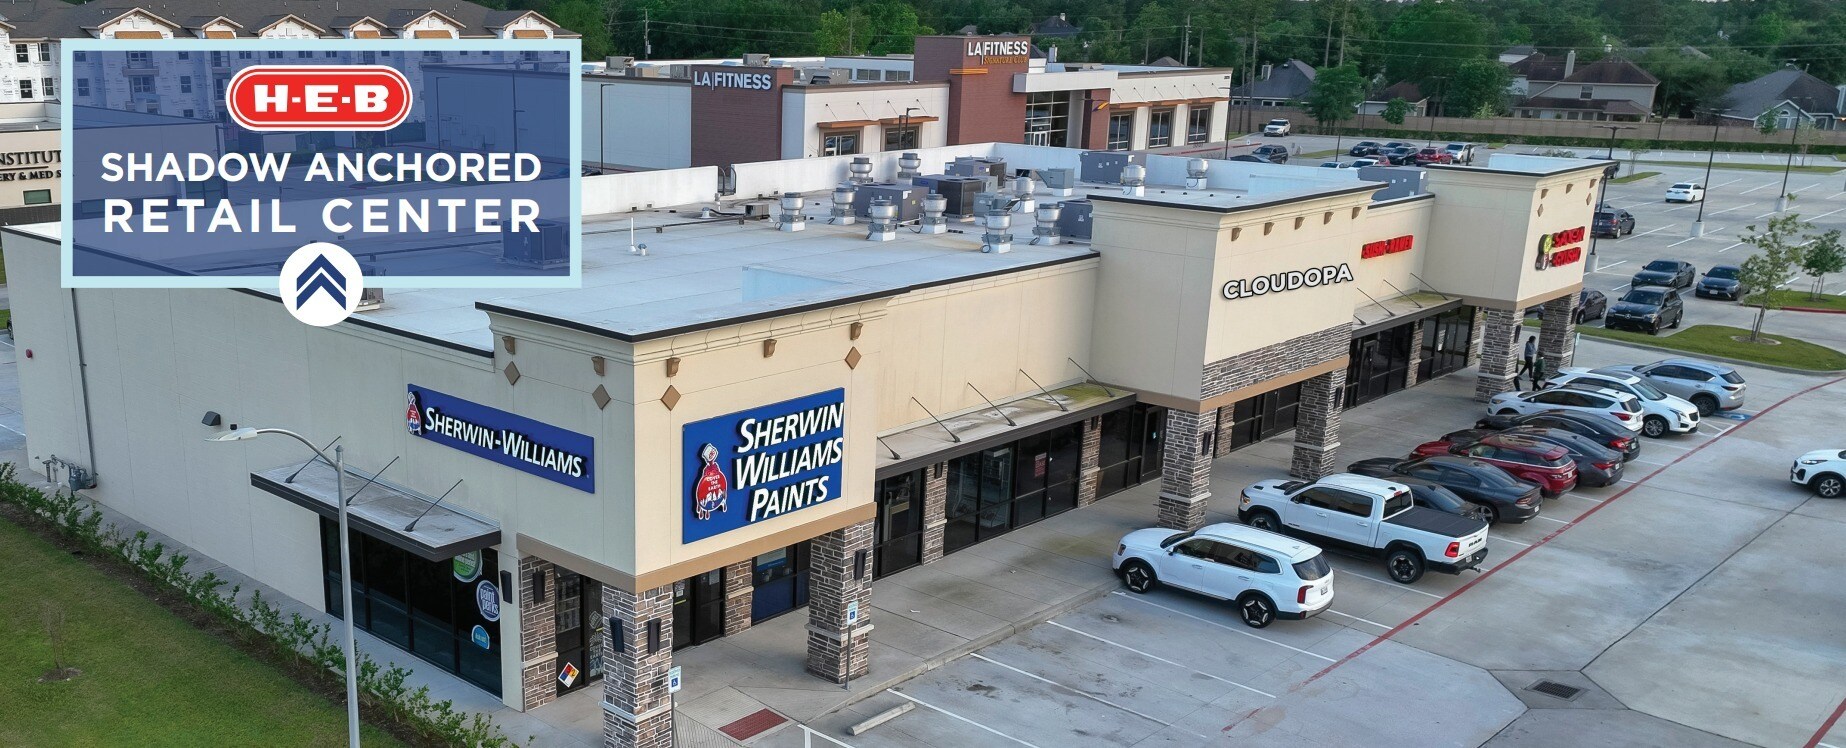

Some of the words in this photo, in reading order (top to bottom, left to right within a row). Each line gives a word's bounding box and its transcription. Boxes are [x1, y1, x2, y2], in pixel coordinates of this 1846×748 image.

[968, 41, 983, 56] LA
[983, 41, 1029, 56] FITNESS
[694, 71, 711, 86] LA
[714, 72, 772, 90] FITNESS
[19, 171, 27, 180] &
[29, 170, 53, 180] MED
[1223, 263, 1354, 300] CLOUDOPA
[737, 402, 845, 453] SHERWIN
[736, 437, 844, 491] WILLIAMS
[750, 475, 830, 522] PAINTS
